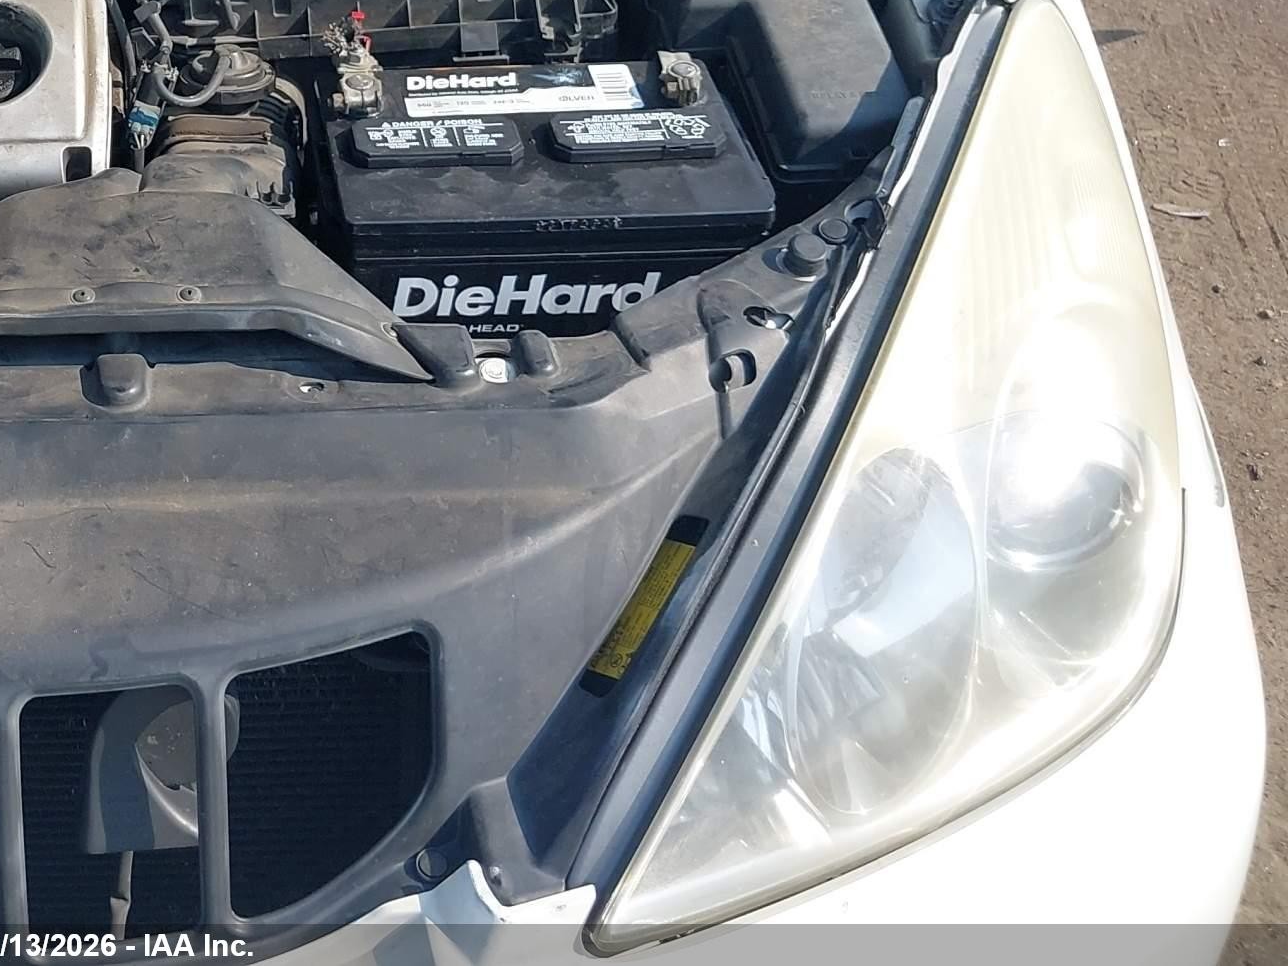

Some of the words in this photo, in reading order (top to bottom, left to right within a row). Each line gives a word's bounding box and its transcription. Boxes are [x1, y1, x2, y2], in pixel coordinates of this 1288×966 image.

[406, 72, 517, 91] DieHard
[392, 120, 435, 128] DANGER
[443, 118, 482, 127] POISON
[392, 271, 662, 317] DieHard
